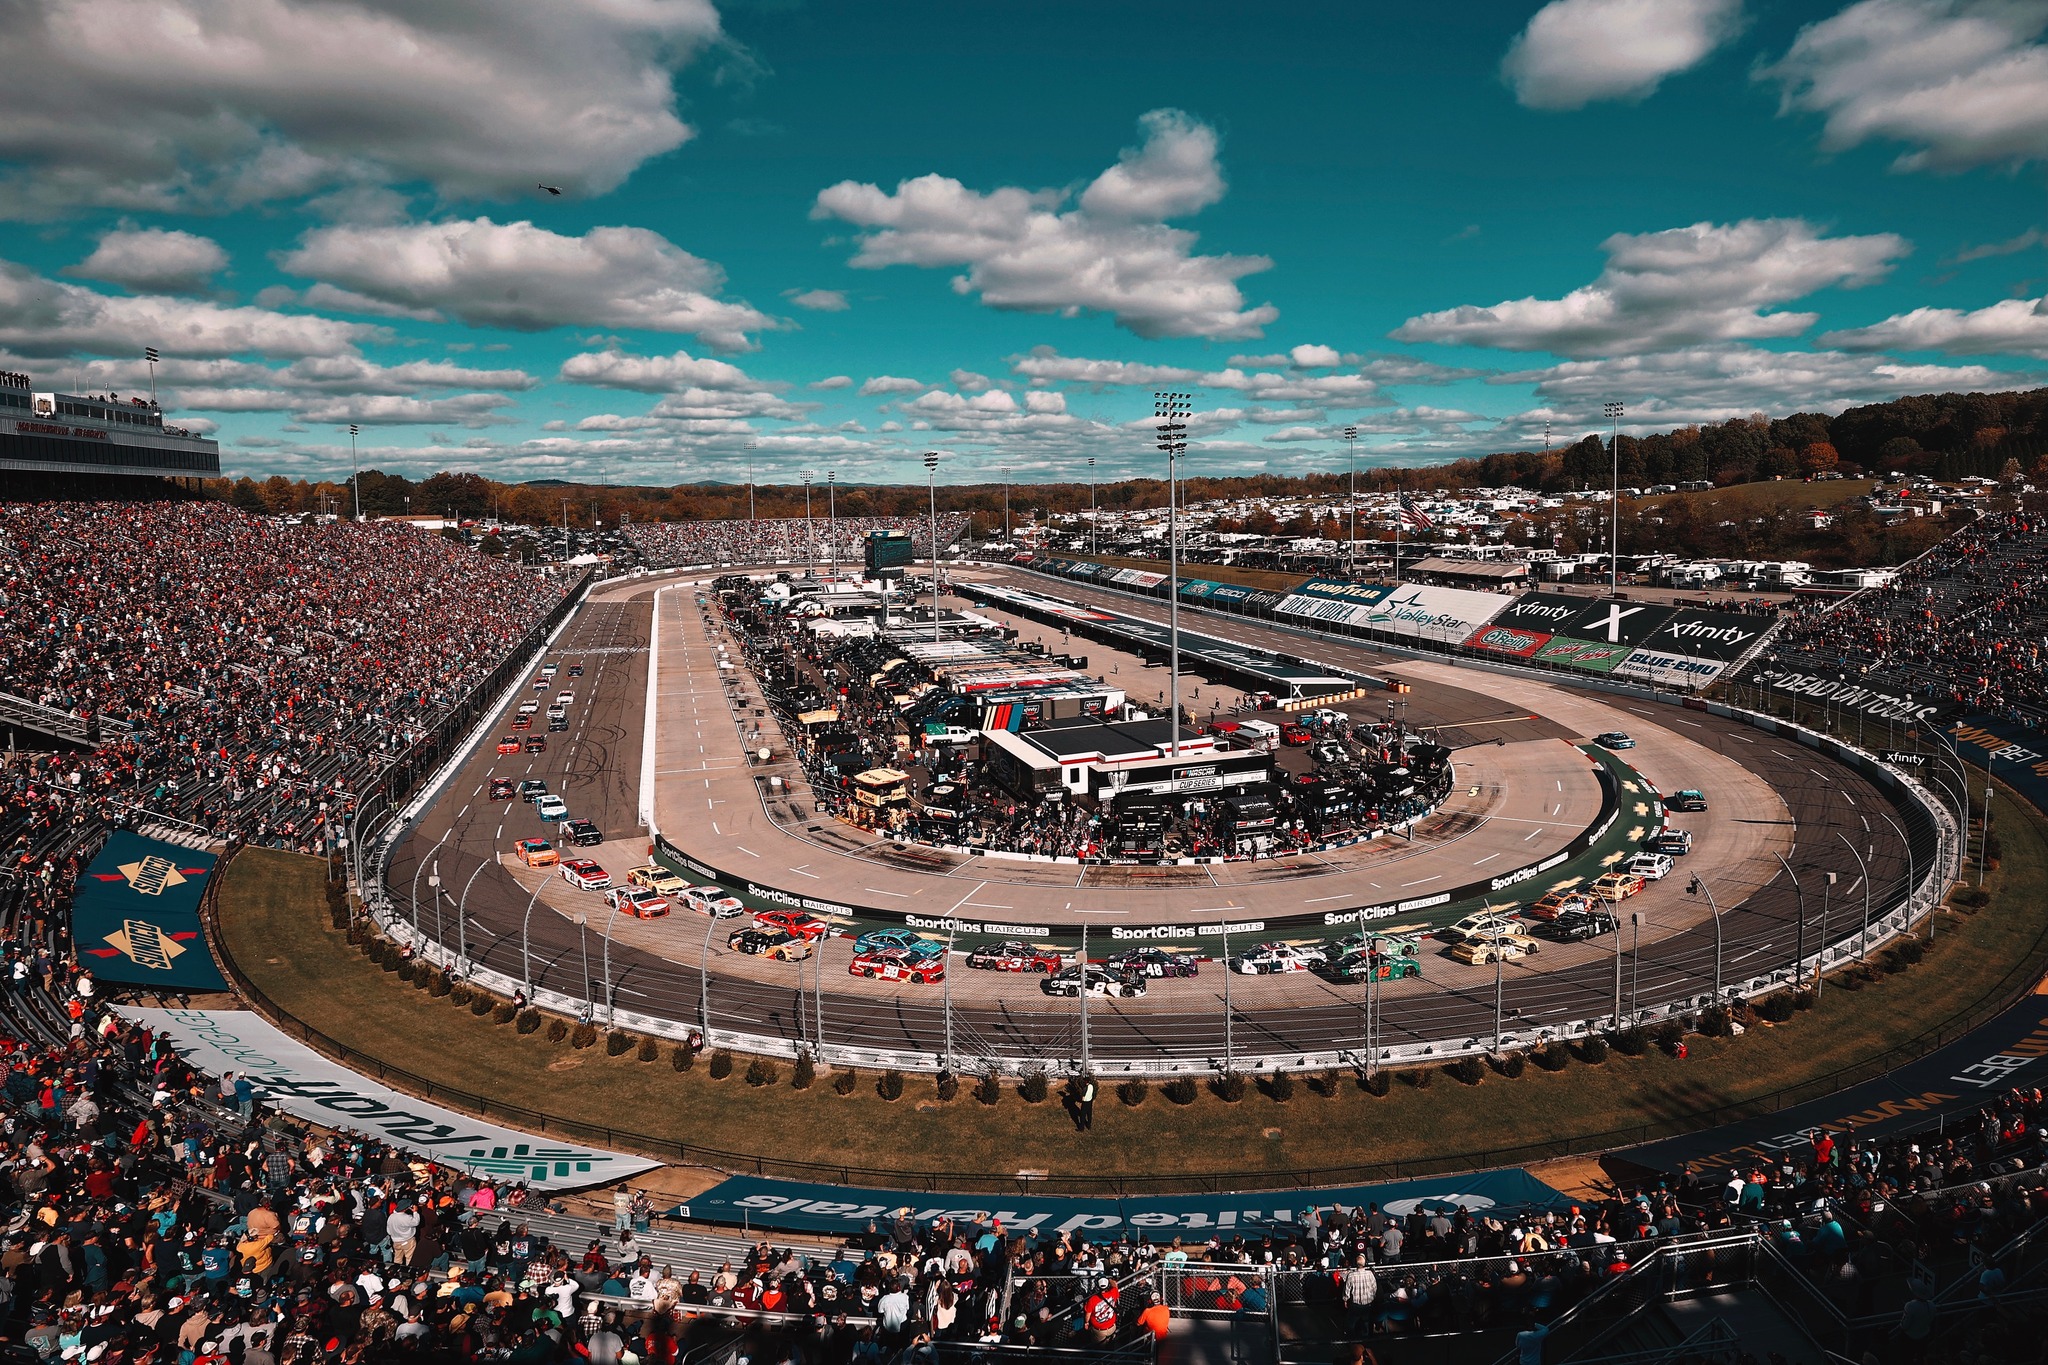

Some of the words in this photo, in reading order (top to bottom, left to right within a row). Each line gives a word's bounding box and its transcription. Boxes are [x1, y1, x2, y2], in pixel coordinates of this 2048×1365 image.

[1214, 588, 1245, 598] GEICO
[1243, 590, 1281, 606] xfinity
[1307, 582, 1382, 600] GOODYEAR
[1282, 595, 1316, 614] DIXIE
[1313, 602, 1358, 621] VODKA
[1510, 601, 1577, 621] xfinity
[1583, 604, 1645, 642] X
[1664, 620, 1756, 646] xfinity
[1620, 662, 1664, 677] Maximum
[1628, 653, 1718, 675] BLUE-EMU
[1292, 685, 1303, 698] X
[1772, 673, 1836, 697] DEAD
[1830, 680, 1871, 706] ON
[1860, 691, 1938, 724] TOOLS
[1886, 751, 1925, 766] xfinity
[1189, 767, 1216, 777] NASCAR
[1180, 780, 1193, 789] CUP
[1194, 778, 1216, 788] SERIES
[1467, 786, 1479, 797] 5
[661, 843, 687, 867] SportClips
[688, 860, 715, 879] HAIRCUTS
[142, 856, 173, 894] SUNOCO
[1491, 866, 1537, 891] SportClips
[748, 883, 801, 908] SportClips
[803, 901, 852, 915] HAIRCUTS
[1324, 904, 1396, 925] SportClips
[1400, 894, 1449, 911] HAIRCUTS
[905, 915, 981, 933] SportClips
[986, 924, 1048, 935] HAIRCUTS
[1112, 926, 1195, 940] SportClips
[1201, 923, 1263, 935] HAIRCUTS
[128, 919, 166, 969] SUNOCO
[755, 943, 766, 954] 14
[1504, 945, 1516, 955] 20
[1008, 958, 1022, 969] 3
[1109, 961, 1124, 970] ally
[1146, 963, 1163, 977] 48
[1377, 966, 1391, 978] 42
[1094, 982, 1106, 994] 8
[165, 1009, 300, 1080] MORTGAGE
[682, 1207, 689, 1216] EE
[733, 1195, 1053, 1229] Rentals
